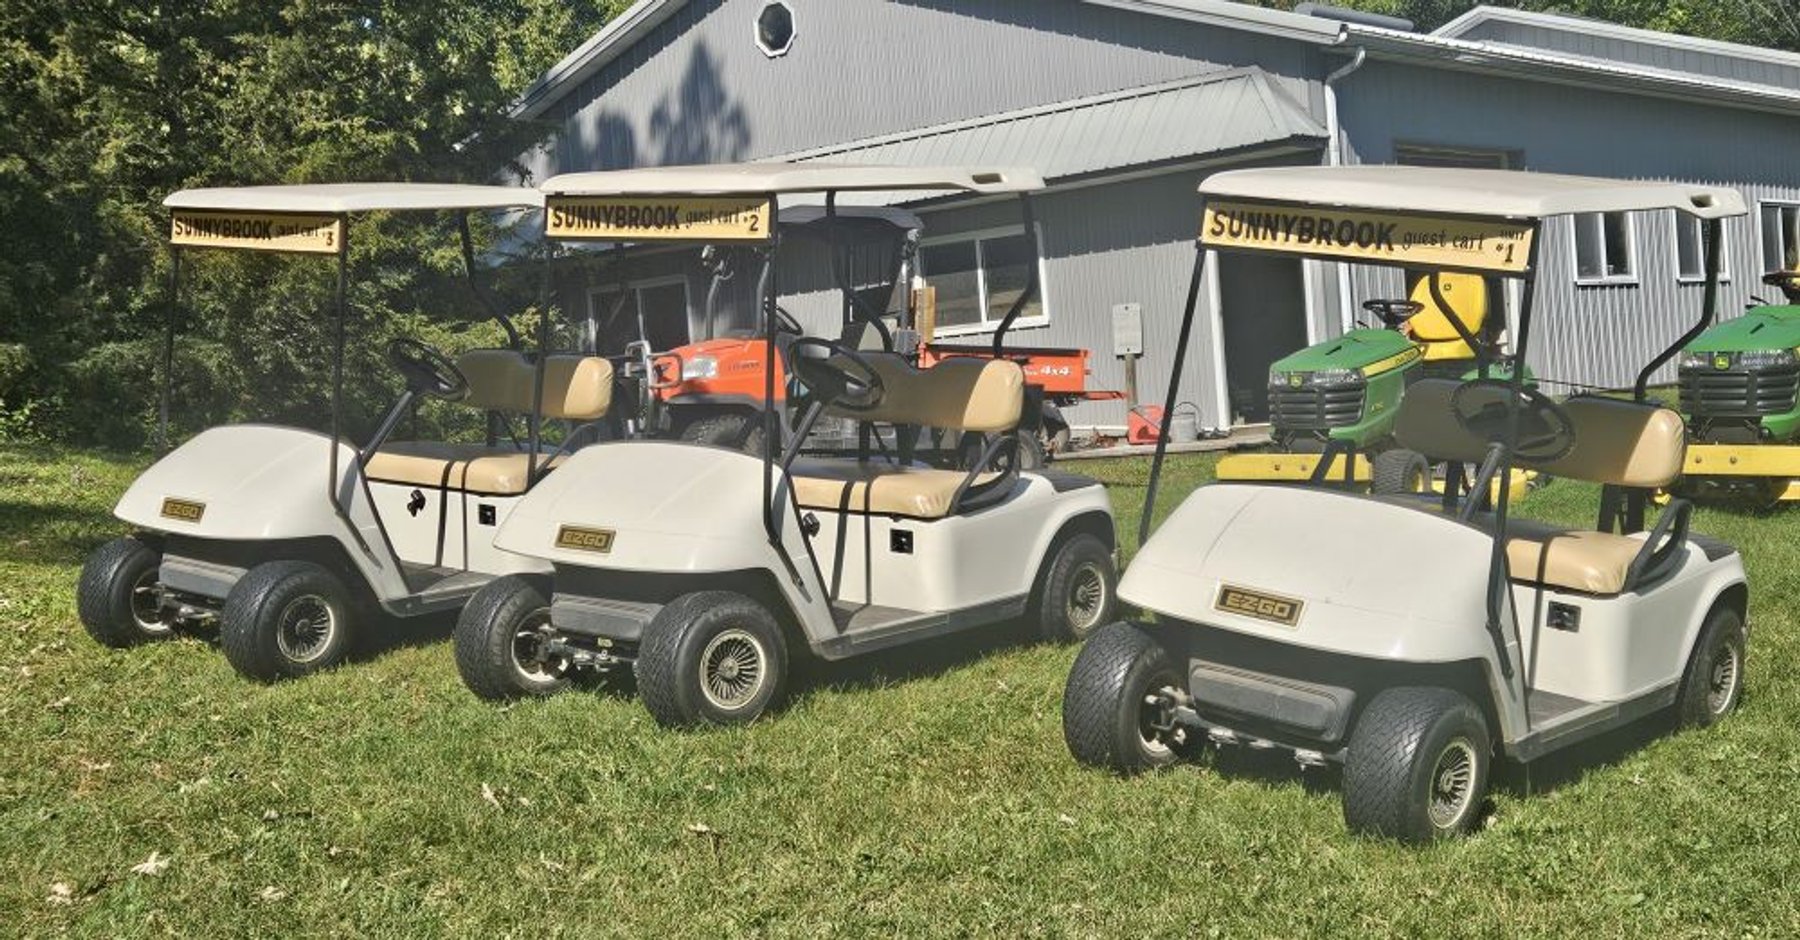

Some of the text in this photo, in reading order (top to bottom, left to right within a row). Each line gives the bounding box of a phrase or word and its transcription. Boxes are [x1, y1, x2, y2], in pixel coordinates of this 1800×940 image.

[174, 216, 272, 241] SUNNYBROOK
[552, 205, 681, 230] SUNNYBROOK
[1210, 208, 1484, 251] SUNNYBROOK guest cart
